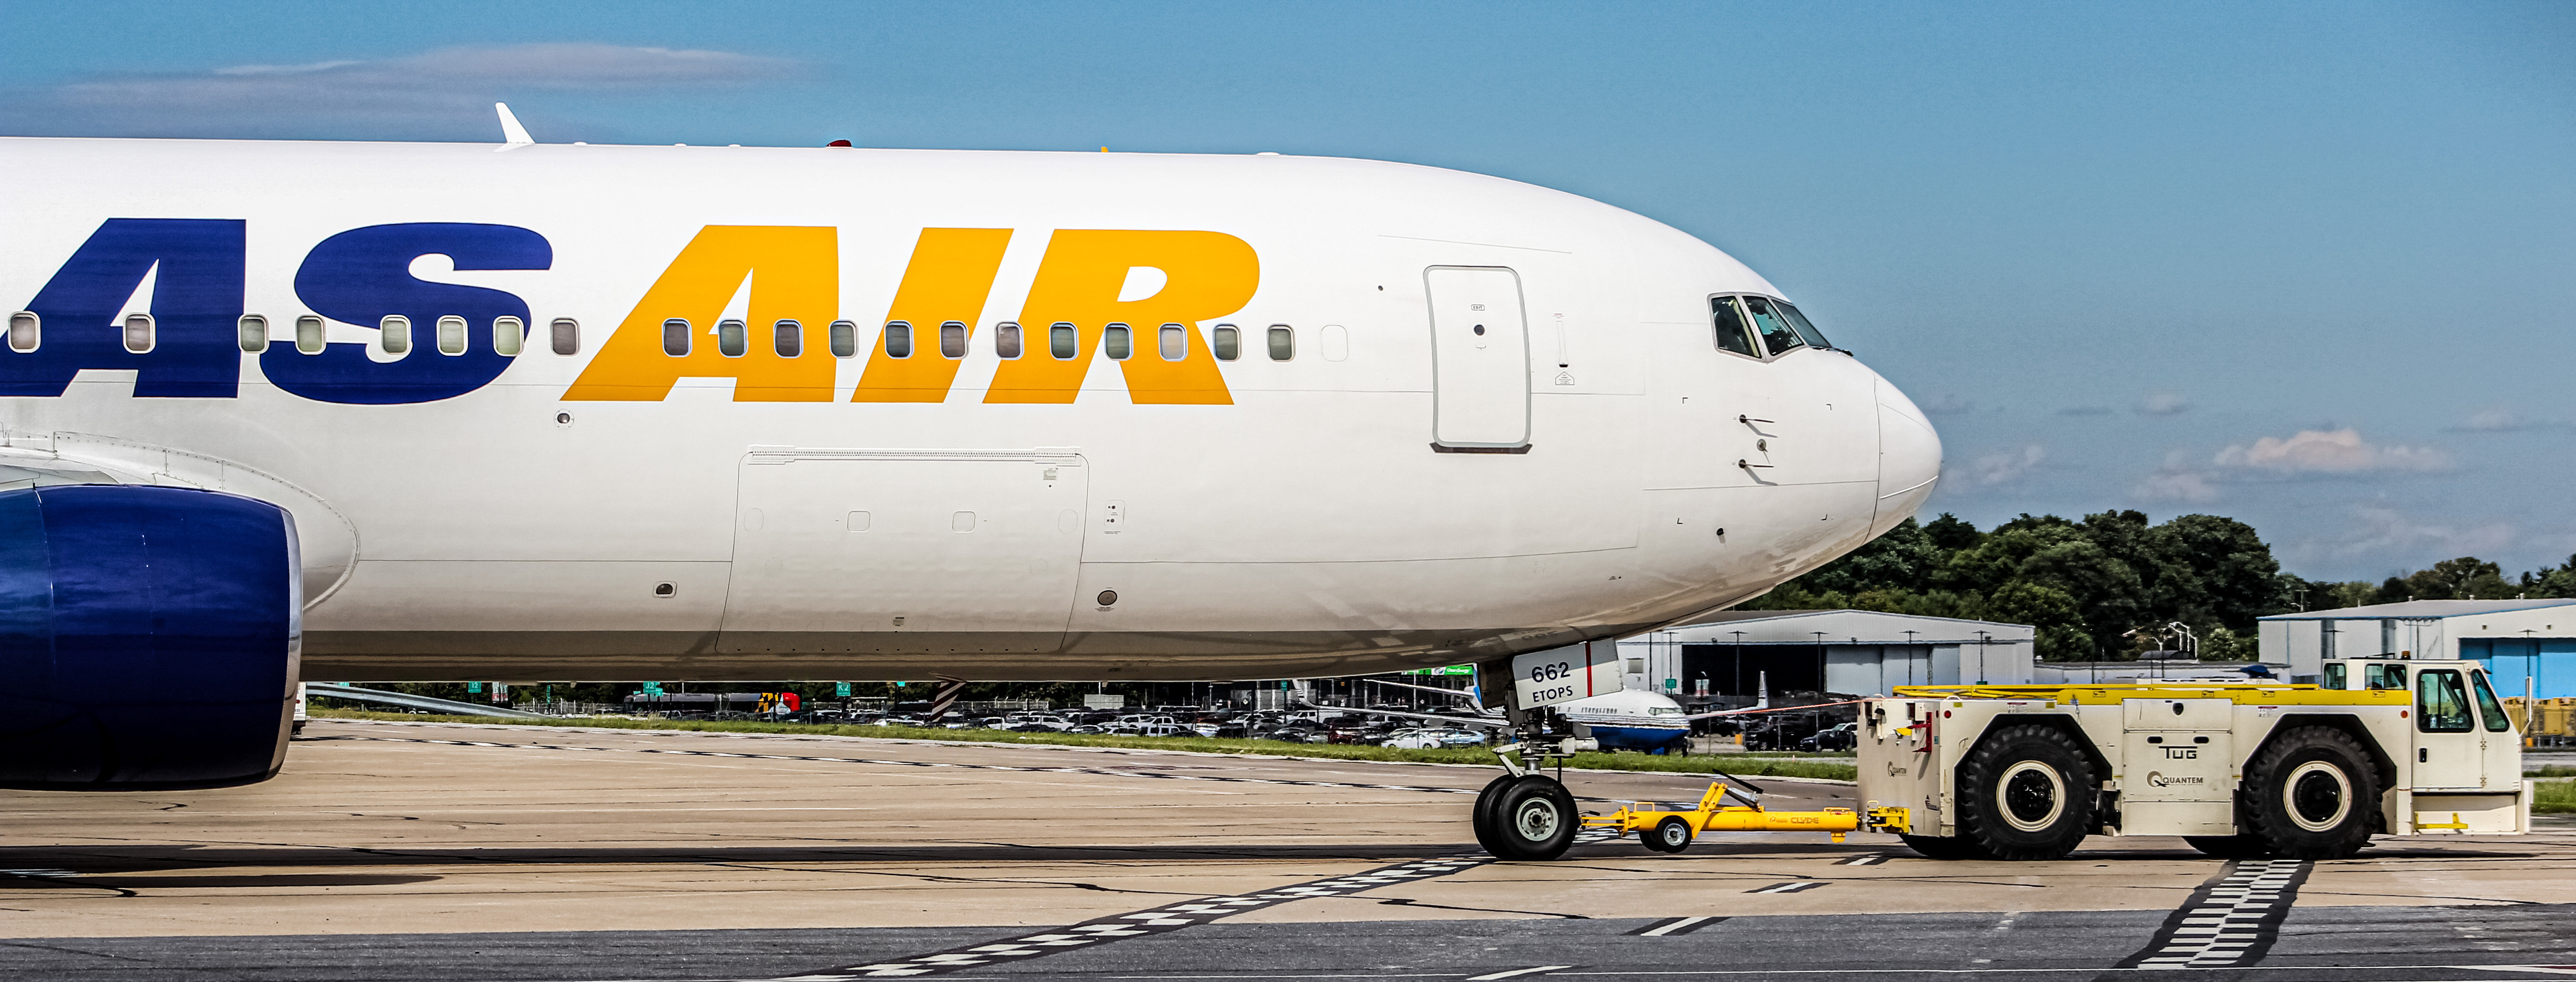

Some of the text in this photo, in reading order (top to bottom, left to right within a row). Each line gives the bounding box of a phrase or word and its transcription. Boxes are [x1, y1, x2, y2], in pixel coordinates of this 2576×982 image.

[560, 225, 1260, 405] AIR
[1531, 662, 1570, 682] 662
[1532, 685, 1573, 702] ETOPS
